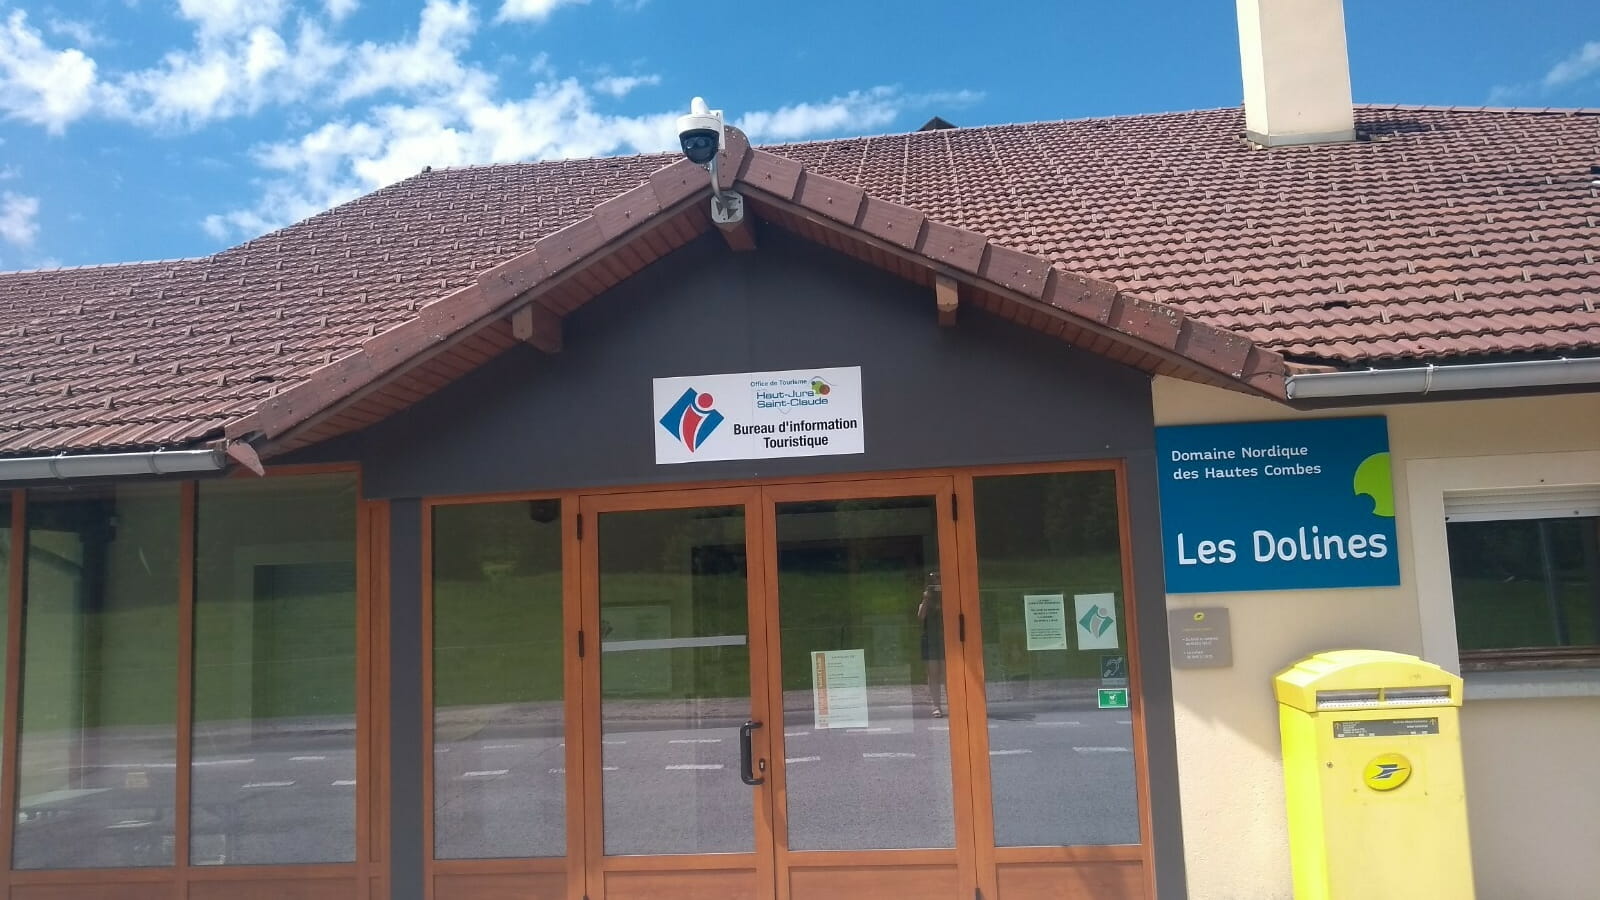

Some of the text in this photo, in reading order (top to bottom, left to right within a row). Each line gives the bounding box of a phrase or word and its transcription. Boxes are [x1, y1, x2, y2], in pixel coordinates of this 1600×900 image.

[750, 380, 769, 388] Office
[779, 378, 808, 386] Tourisme
[756, 390, 815, 400] Haut-Jura
[757, 397, 829, 408] Saint-Claude
[733, 418, 858, 435] Bureau d'information
[763, 435, 829, 449] Touristique
[1171, 444, 1309, 462] Domaine Nordique
[1173, 462, 1322, 480] des Hautes Combes
[1177, 525, 1388, 565] Les Dolines
